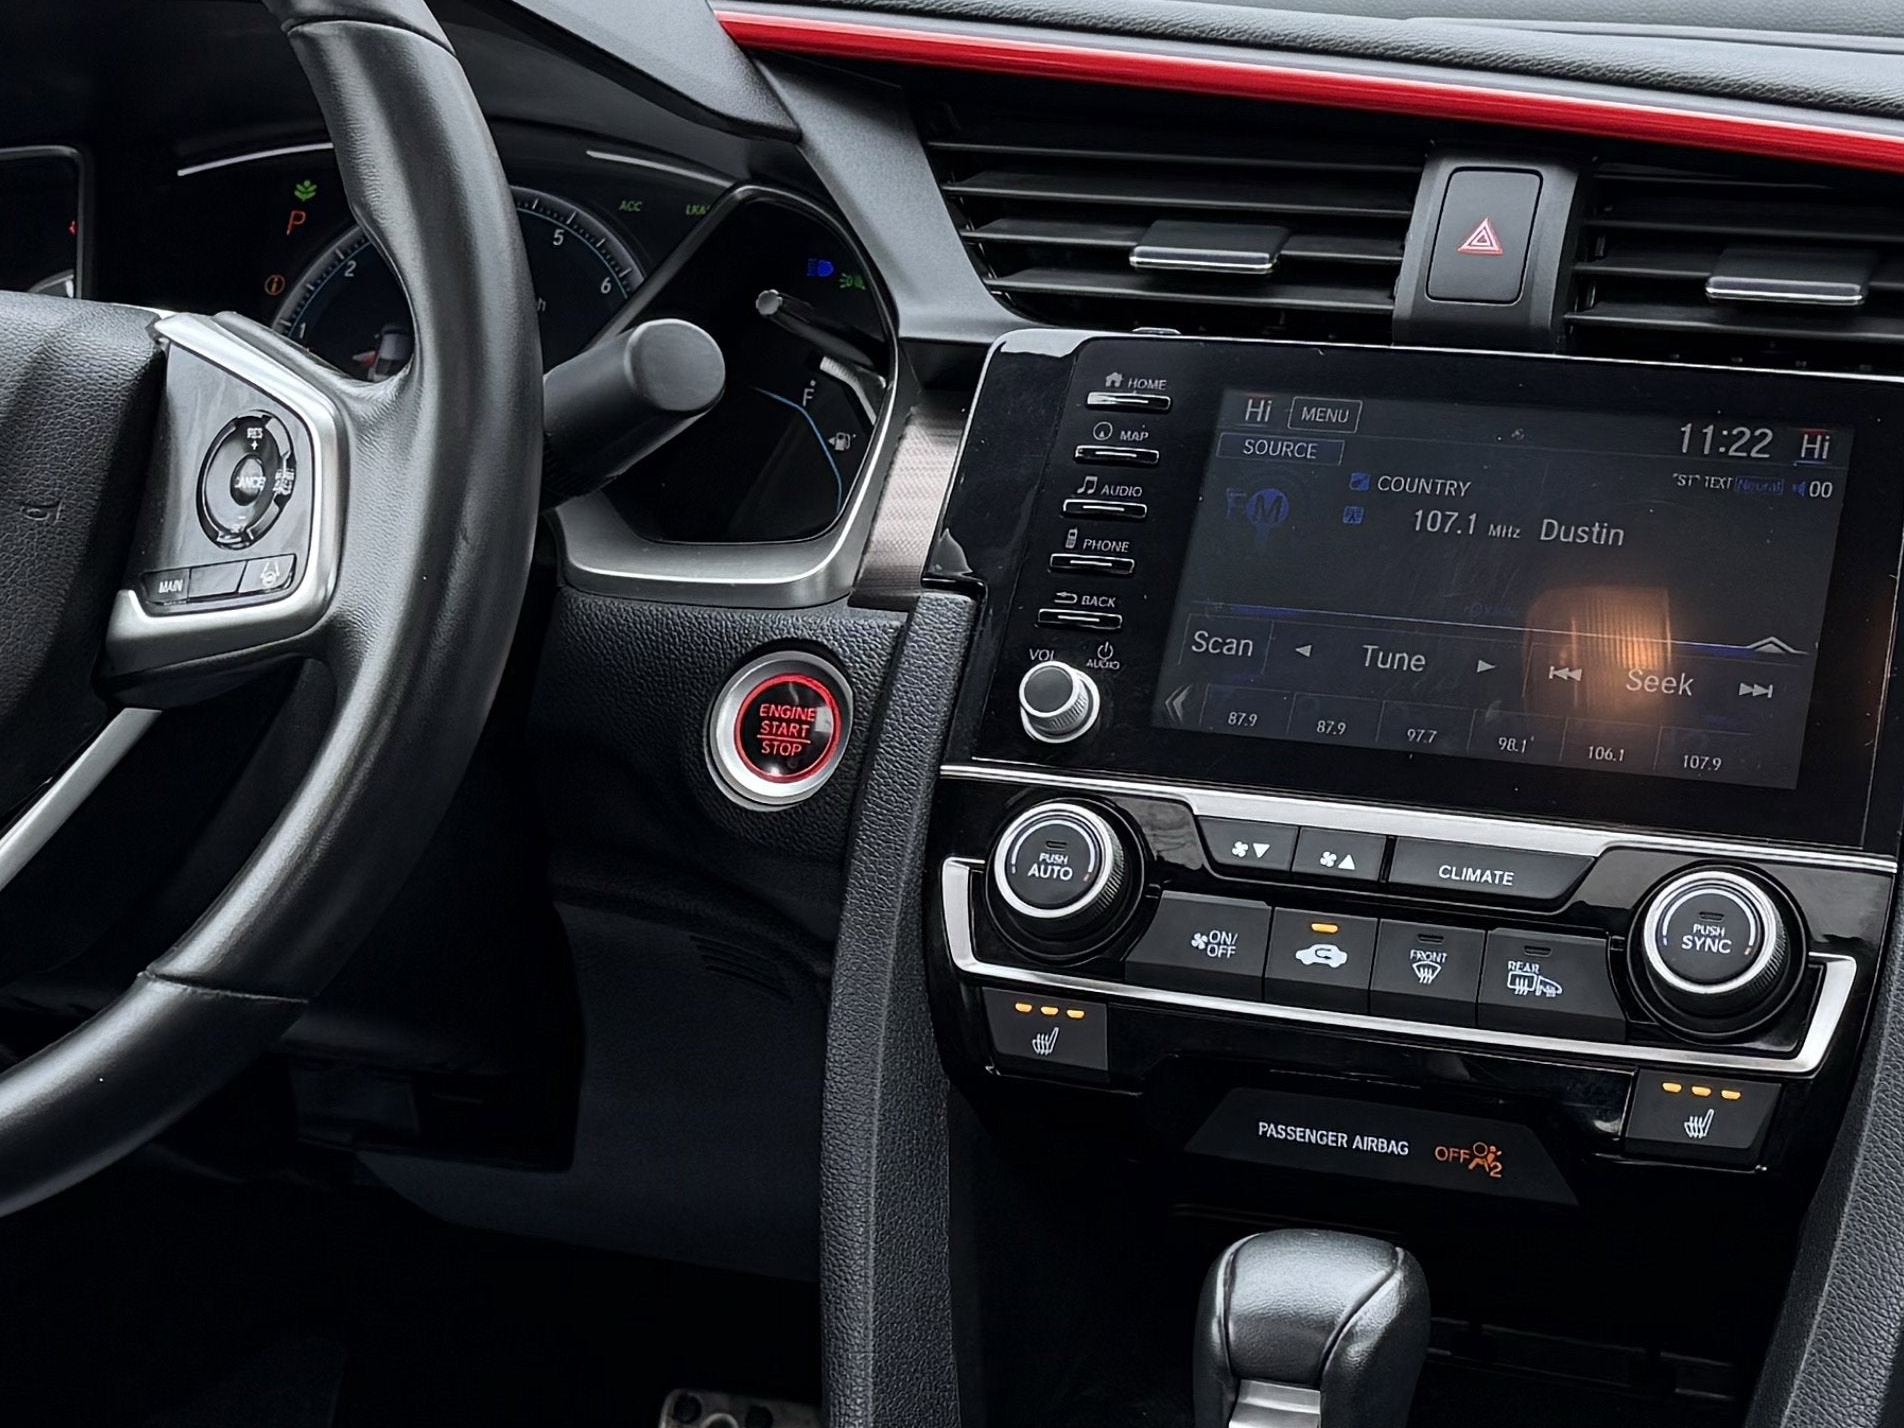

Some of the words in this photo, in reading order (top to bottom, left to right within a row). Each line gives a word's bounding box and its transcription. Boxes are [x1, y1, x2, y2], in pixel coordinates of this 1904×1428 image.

[685, 204, 710, 216] LKA
[552, 229, 565, 246] 5
[344, 260, 357, 277] 2
[600, 276, 612, 294] 6
[1127, 378, 1168, 391] HOME
[1244, 399, 1271, 423] Hi
[1301, 406, 1350, 424] MENU
[1119, 429, 1149, 442] MAP
[1679, 422, 1774, 458] 11:22
[1242, 439, 1318, 460] SOURCE
[1799, 434, 1831, 460] Hi
[1100, 484, 1143, 498] AUDIO
[1377, 475, 1471, 497] COUNTRY
[1809, 480, 1833, 499] 00
[1413, 509, 1478, 535] 107.1
[1488, 523, 1521, 539] MHz
[1540, 519, 1625, 547] Dustin
[1082, 538, 1130, 553] PHONE
[158, 579, 184, 594] MAIN
[1081, 595, 1116, 608] BACK
[1191, 630, 1253, 657] Scan
[1086, 658, 1120, 670] AUDIO
[1362, 645, 1426, 672] Tune
[1625, 668, 1695, 696] Seek
[758, 702, 817, 722] ENGINE
[1227, 711, 1258, 727] 87.9
[760, 720, 811, 738] START
[1316, 720, 1347, 736] 87.9
[1406, 728, 1438, 744] 97.7
[761, 740, 802, 757] STOP
[1587, 745, 1625, 762] 106.1
[1682, 754, 1722, 771] 107.9
[1038, 852, 1069, 866] PUSH
[1027, 865, 1074, 882] AUTO
[1438, 864, 1515, 887] CLIMATE
[1692, 923, 1726, 938] PUSH
[1206, 944, 1237, 959] OFF
[1681, 935, 1733, 955] SYNC
[1409, 949, 1448, 964] FRONT
[1507, 960, 1540, 974] REAR
[1258, 1121, 1348, 1149] PASSENGER
[1352, 1134, 1410, 1157] AIRBAG
[1434, 1145, 1470, 1163] OFF
